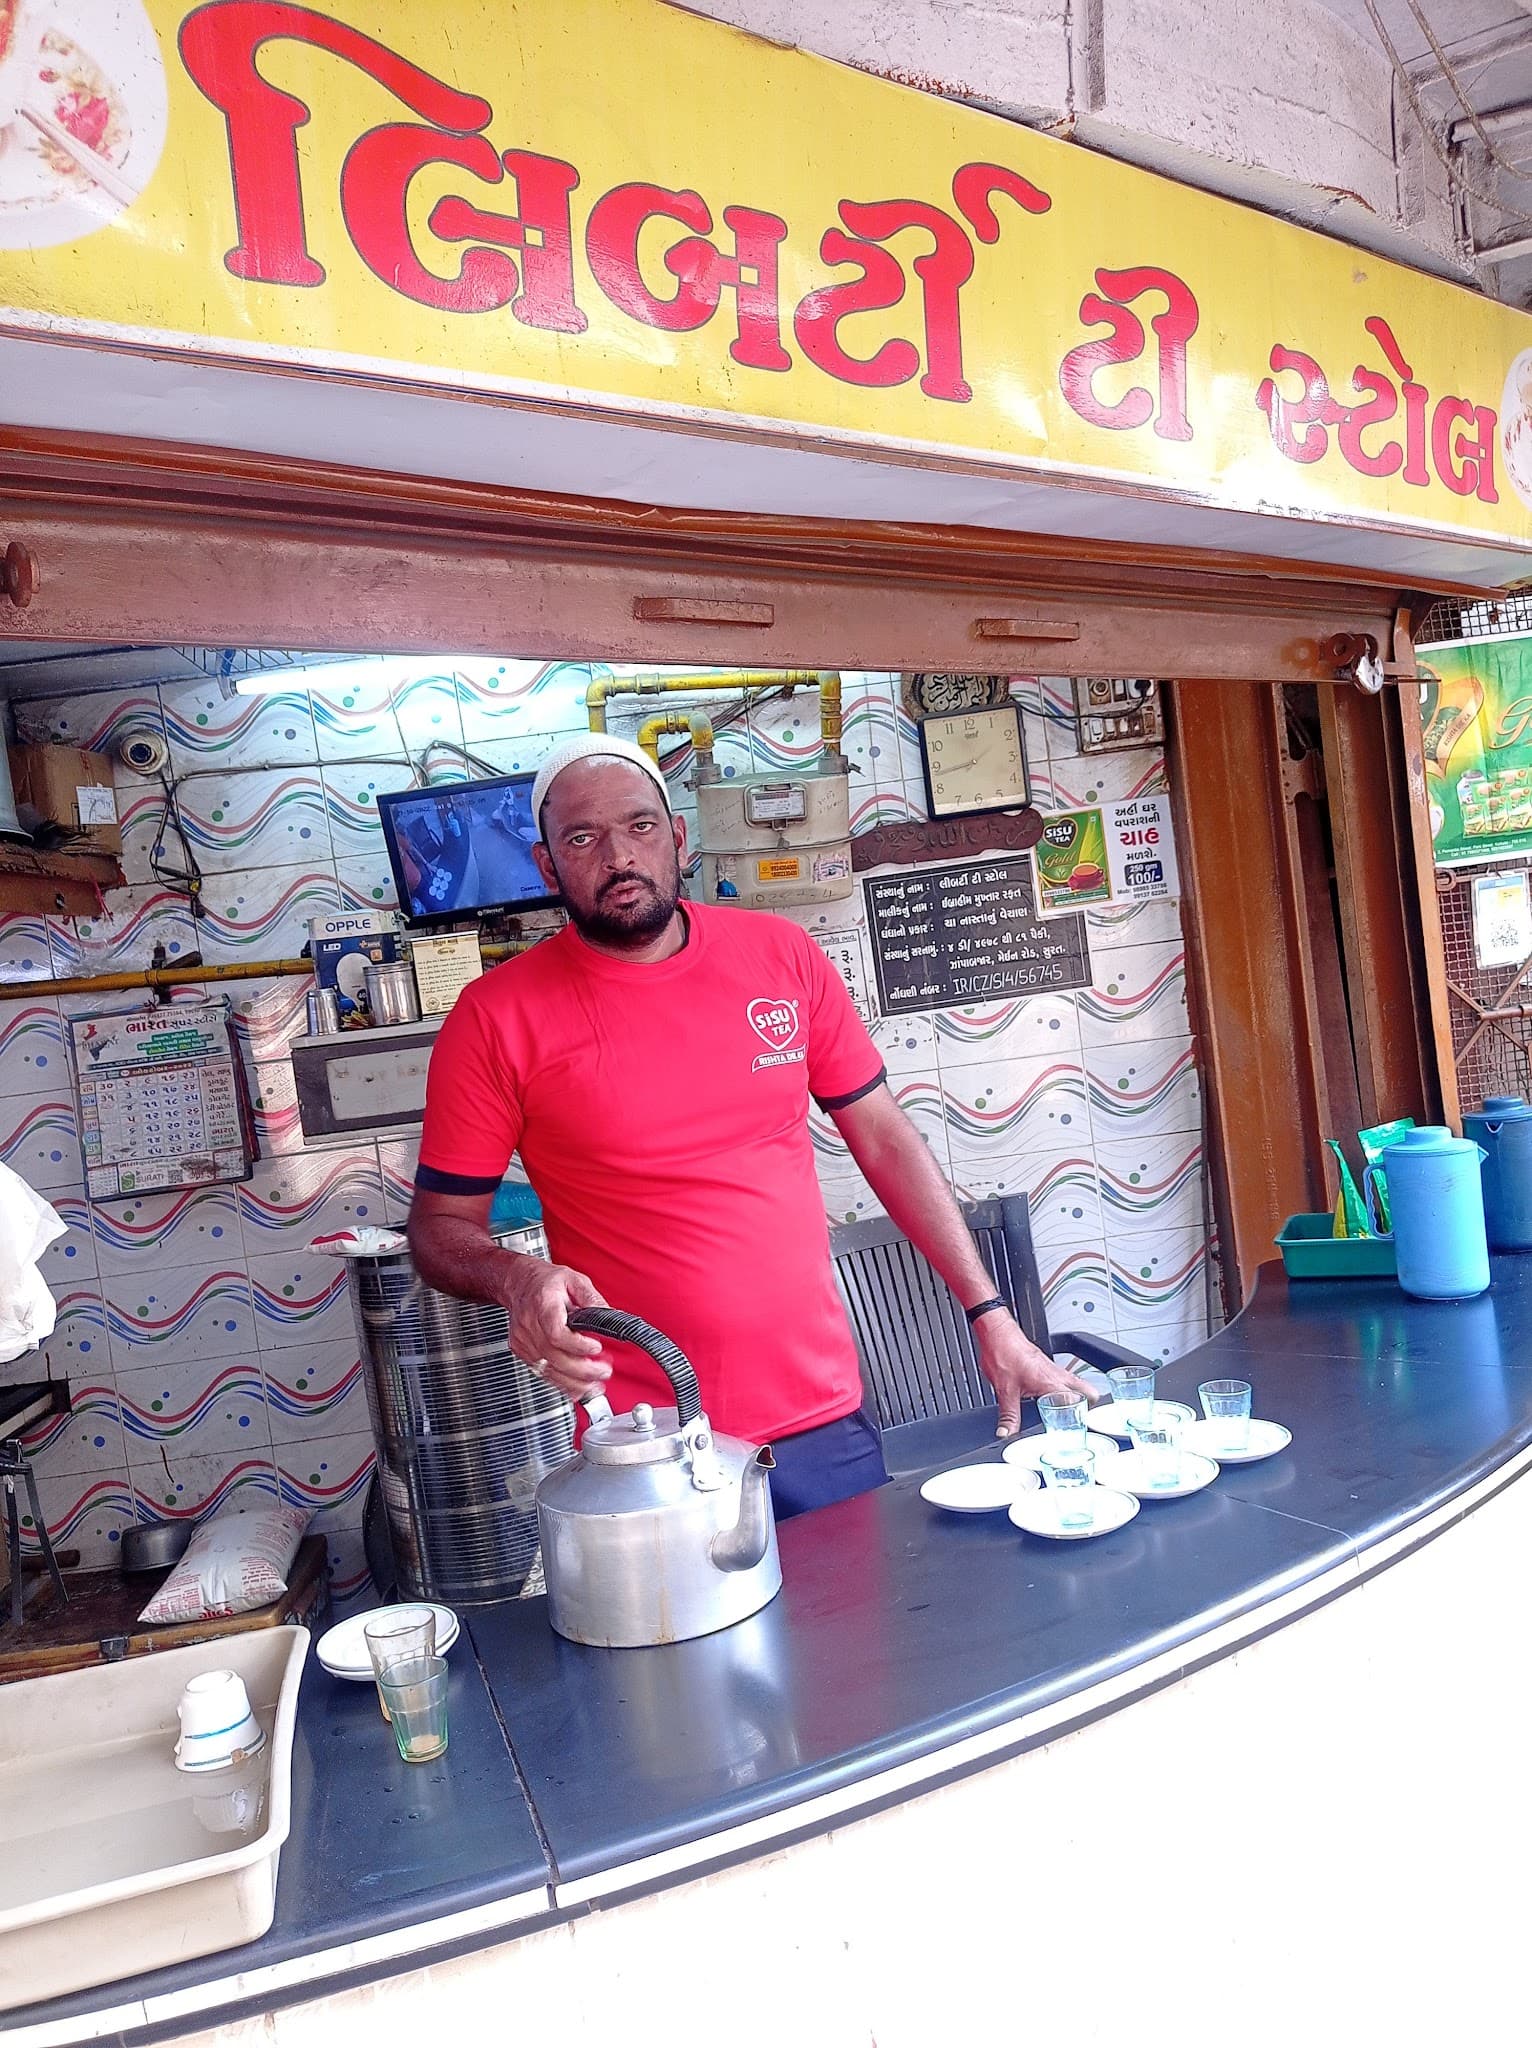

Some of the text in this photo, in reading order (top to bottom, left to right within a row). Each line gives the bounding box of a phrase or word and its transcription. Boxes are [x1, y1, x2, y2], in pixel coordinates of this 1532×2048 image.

[1059, 266, 1199, 443] ટી
[1256, 315, 1499, 504] સ્ટોલ
[945, 723, 953, 735] 11
[964, 718, 975, 731] 12
[989, 718, 994, 729] 1
[1004, 730, 1013, 741] 2
[932, 740, 943, 752] 10
[1008, 752, 1016, 762] 3
[932, 762, 941, 772] 9
[1010, 772, 1017, 784] 4
[936, 784, 945, 794] 8
[955, 795, 962, 806] 7
[974, 794, 983, 804] 6
[1115, 803, 1157, 817] અહીં ઘર
[1114, 812, 1160, 828] વપરાશની
[1120, 828, 1160, 846] ચાહ
[1045, 851, 1078, 868] Gold
[1126, 848, 1157, 861] મળશે.
[1130, 864, 1144, 872] 250
[907, 883, 924, 894] નામ
[971, 872, 982, 884] ટી
[984, 869, 1008, 882] સ્ટોલ
[1128, 871, 1160, 885] 100/-
[912, 903, 928, 913] નામ
[325, 918, 372, 932] OPPLE
[908, 925, 928, 936] પ્રકાર
[944, 918, 956, 928] ચા
[1002, 932, 1012, 944] થી
[323, 943, 341, 952] LED
[920, 982, 940, 995] નંબર
[126, 1020, 168, 1034] ભારત
[771, 1023, 792, 1036] TEA
[136, 1174, 164, 1184] SURATI
